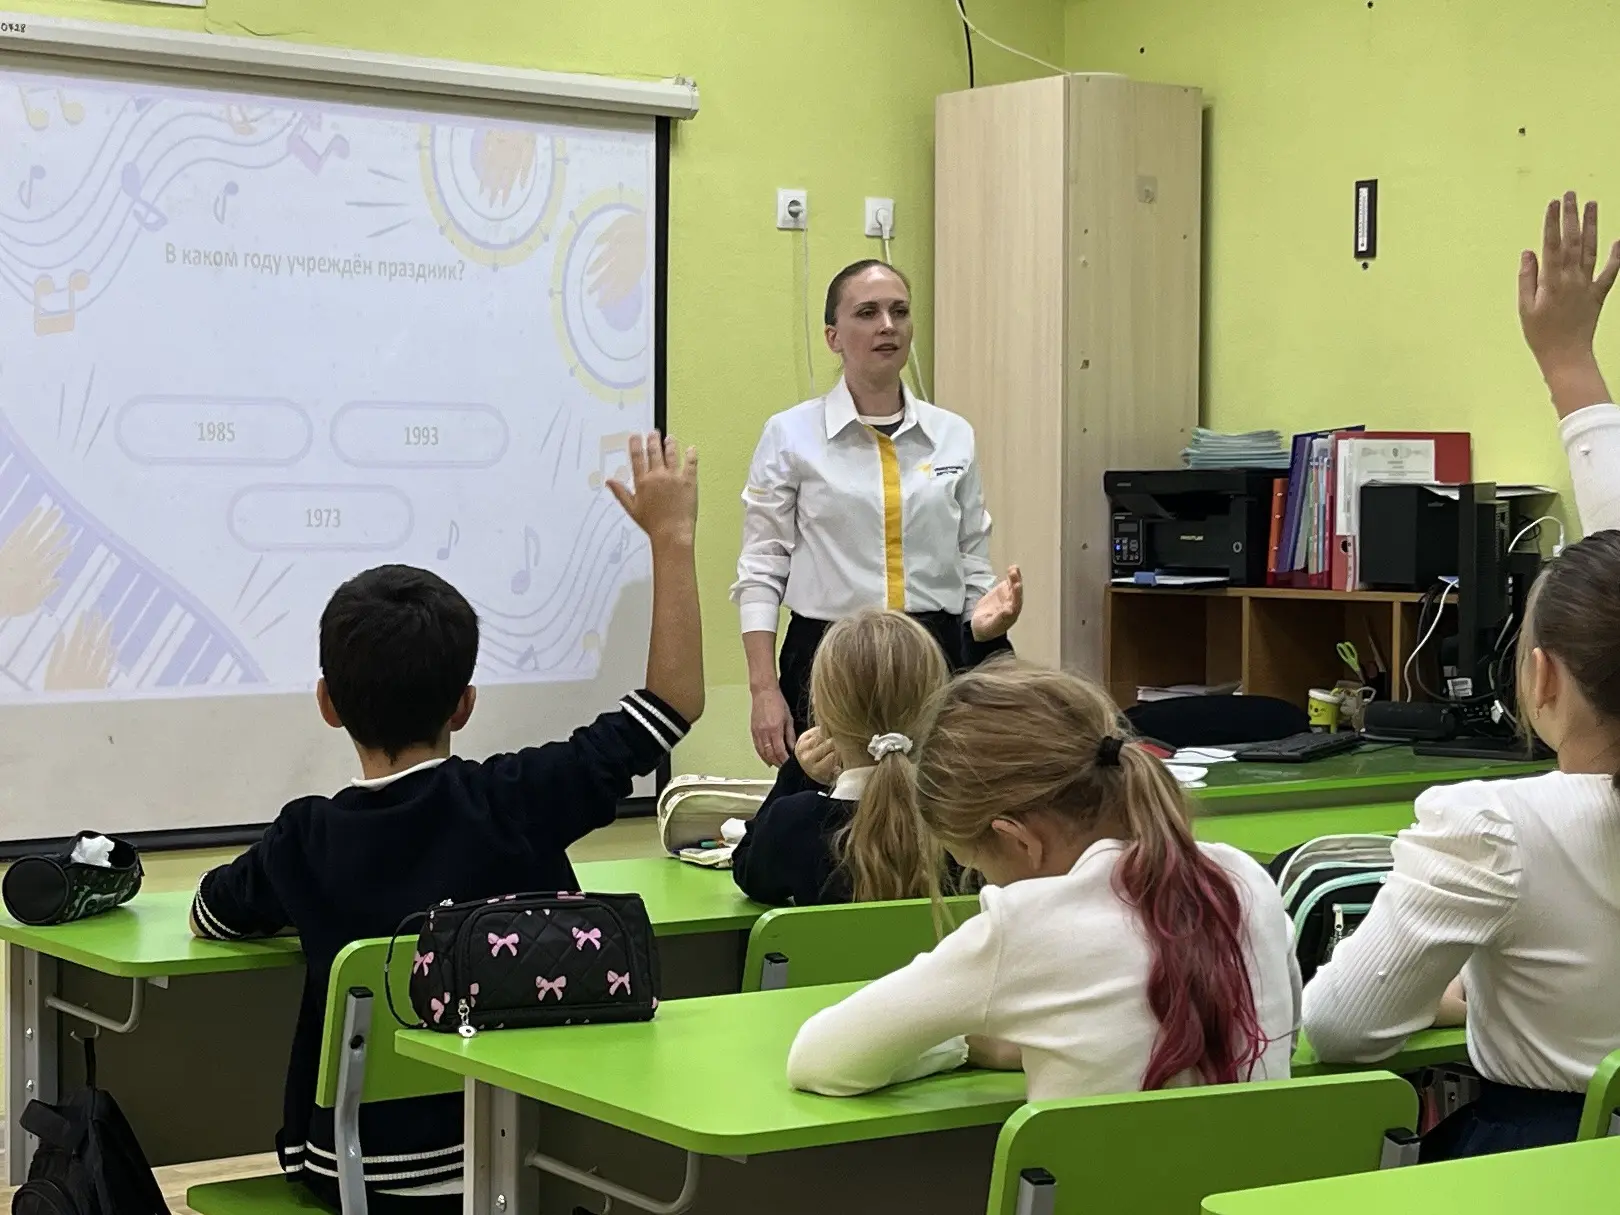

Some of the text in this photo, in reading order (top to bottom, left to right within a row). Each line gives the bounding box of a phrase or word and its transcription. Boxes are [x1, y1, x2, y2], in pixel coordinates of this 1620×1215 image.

[165, 242, 466, 284] В каком году учреждён праздник?
[197, 421, 236, 442] 1985
[404, 426, 439, 446] 1993
[305, 508, 342, 528] 1973
